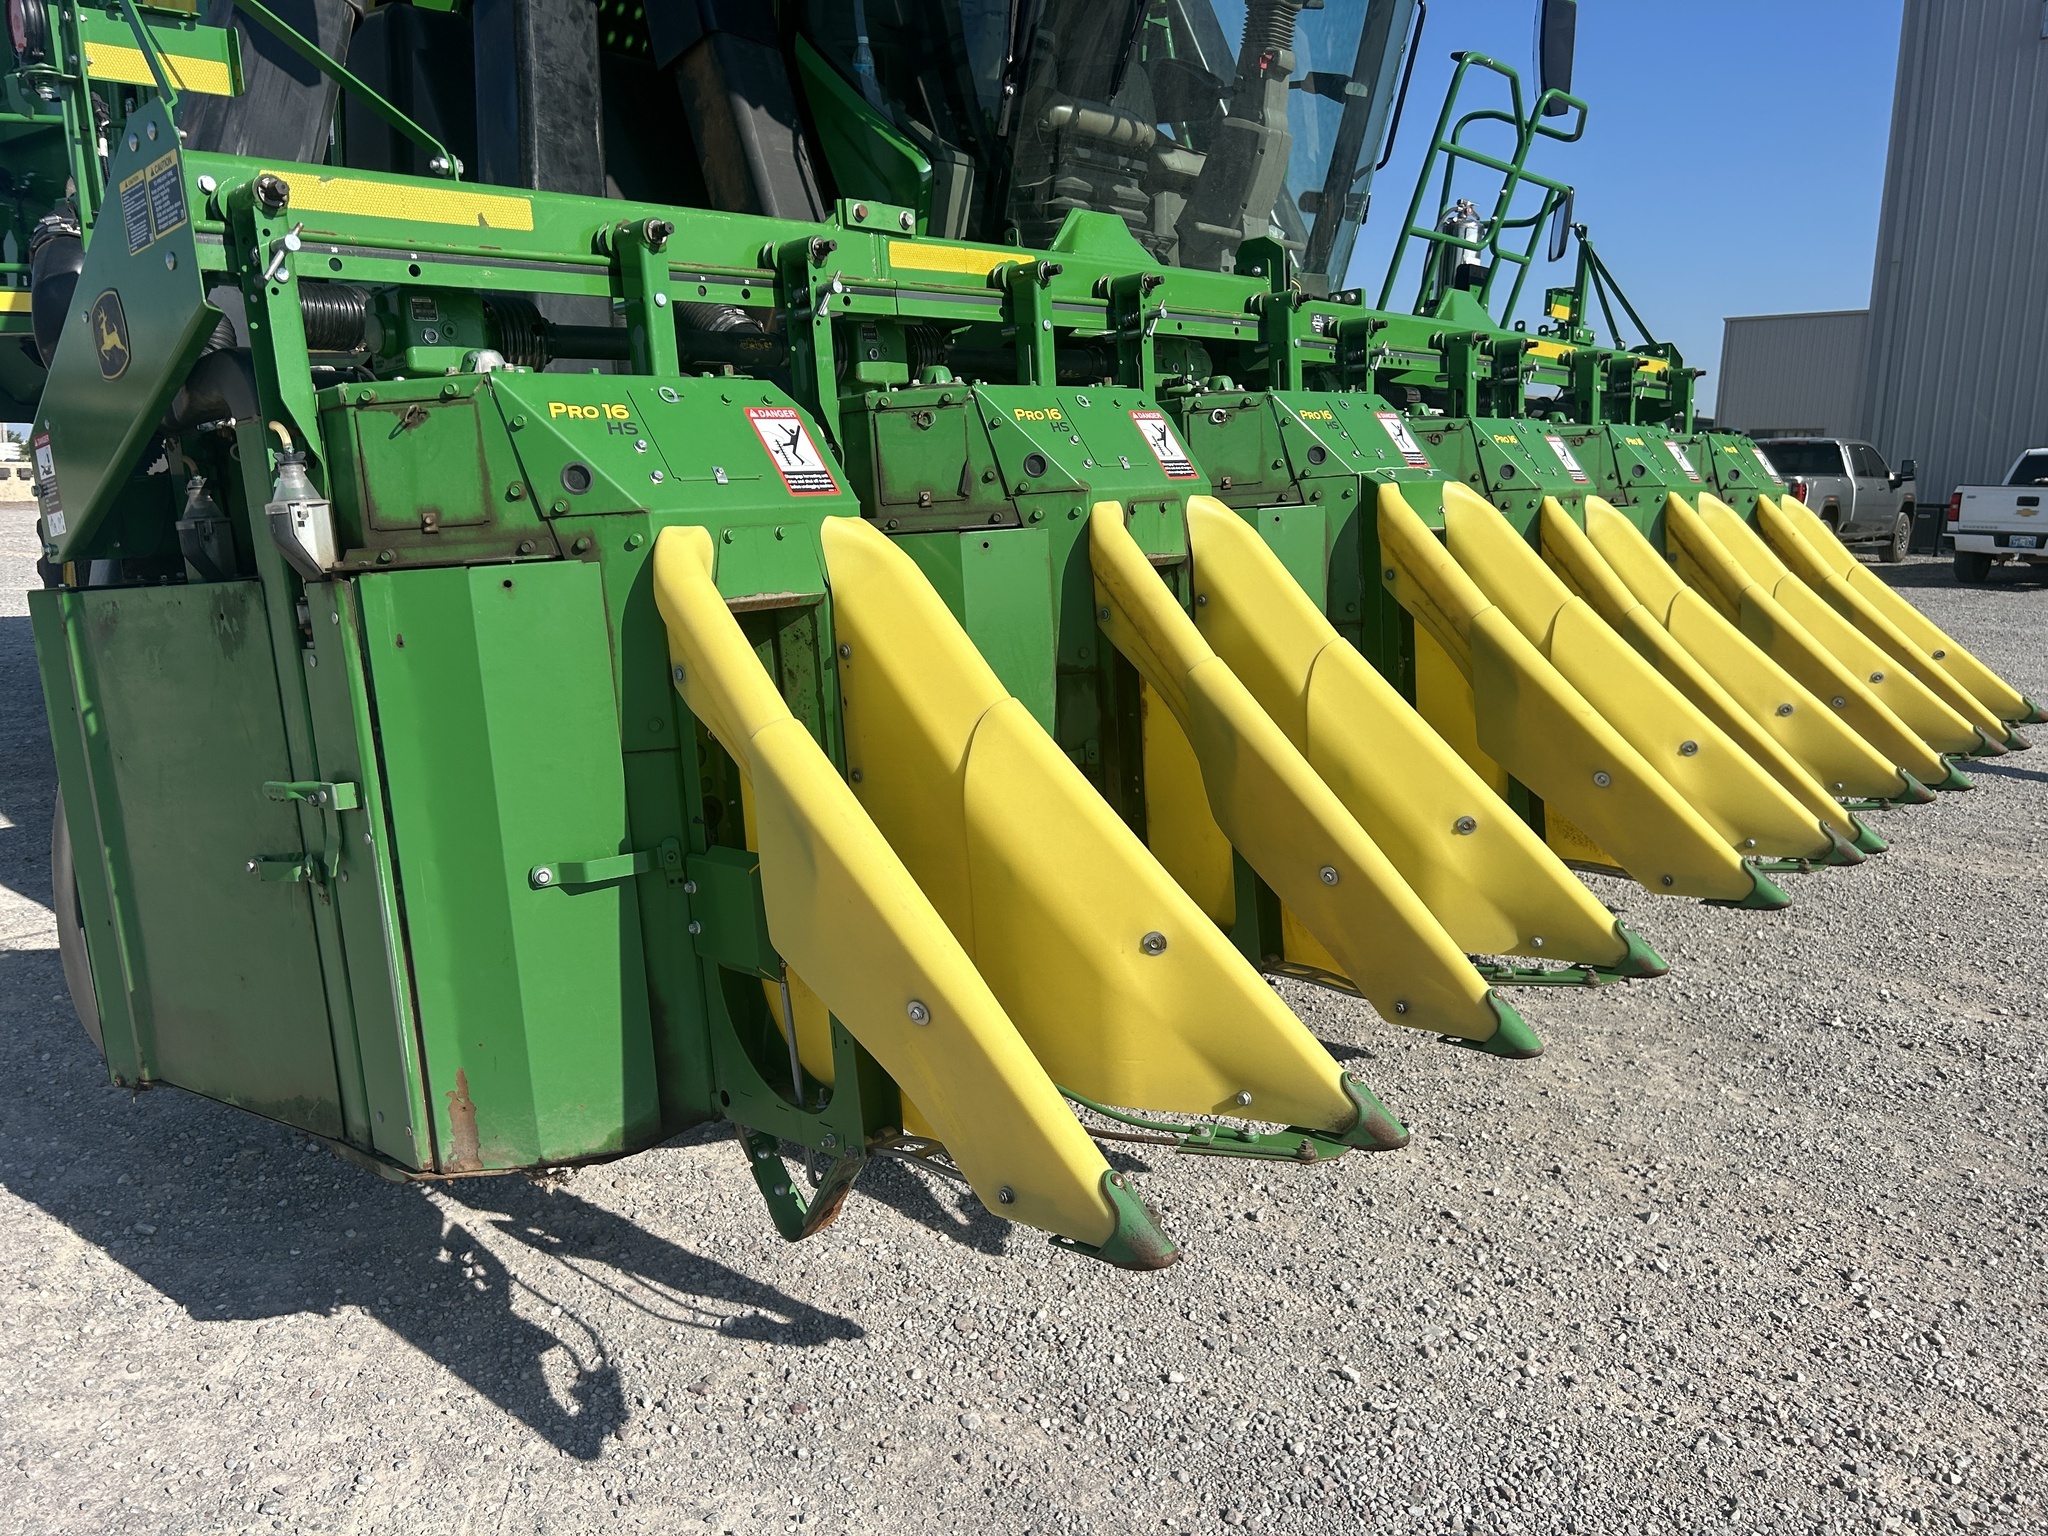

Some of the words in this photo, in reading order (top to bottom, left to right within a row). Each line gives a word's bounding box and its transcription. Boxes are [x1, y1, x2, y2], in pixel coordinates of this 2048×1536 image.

[601, 403, 631, 420] 16
[757, 409, 797, 418] DANGER
[1043, 408, 1062, 420] 16
[1137, 411, 1163, 419] DANGER
[1319, 409, 1333, 420] 16
[606, 421, 639, 435] HS
[1050, 421, 1070, 432] HS
[1325, 421, 1340, 430] HS
